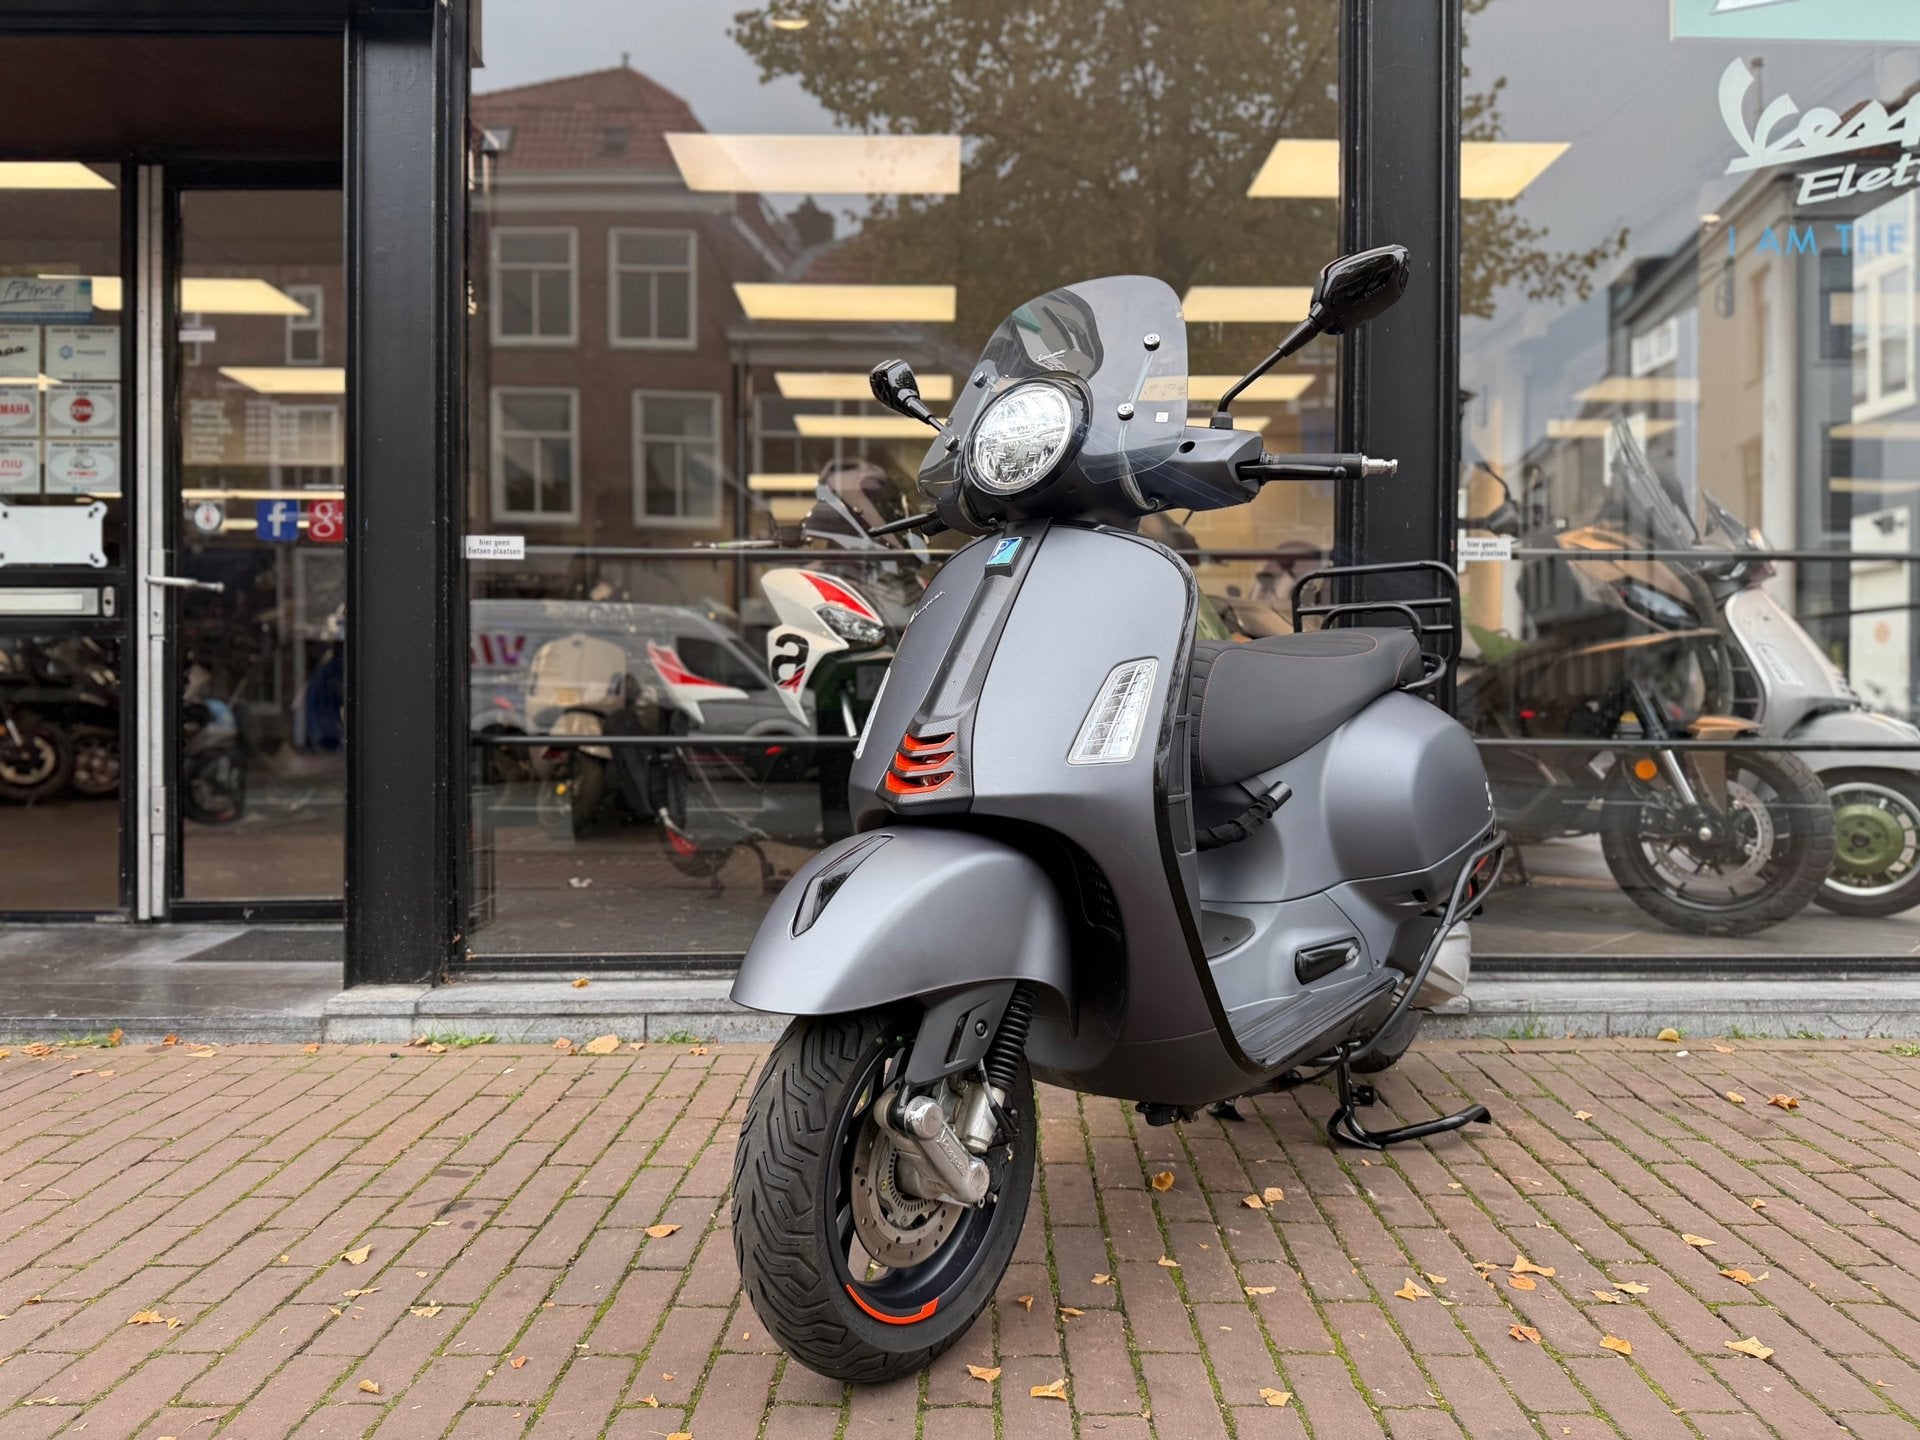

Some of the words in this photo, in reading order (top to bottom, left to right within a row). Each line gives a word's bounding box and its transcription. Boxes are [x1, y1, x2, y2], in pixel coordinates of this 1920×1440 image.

[1797, 153, 1920, 205] Elet
[1728, 225, 1736, 256] I
[1756, 225, 1818, 256] AM
[1835, 224, 1906, 256] THE
[479, 538, 492, 546] hier
[494, 539, 510, 547] geen
[1482, 541, 1497, 550] geen
[468, 546, 491, 554] fietsen
[493, 547, 521, 556] plaatsen
[1480, 550, 1508, 558] plaatsen
